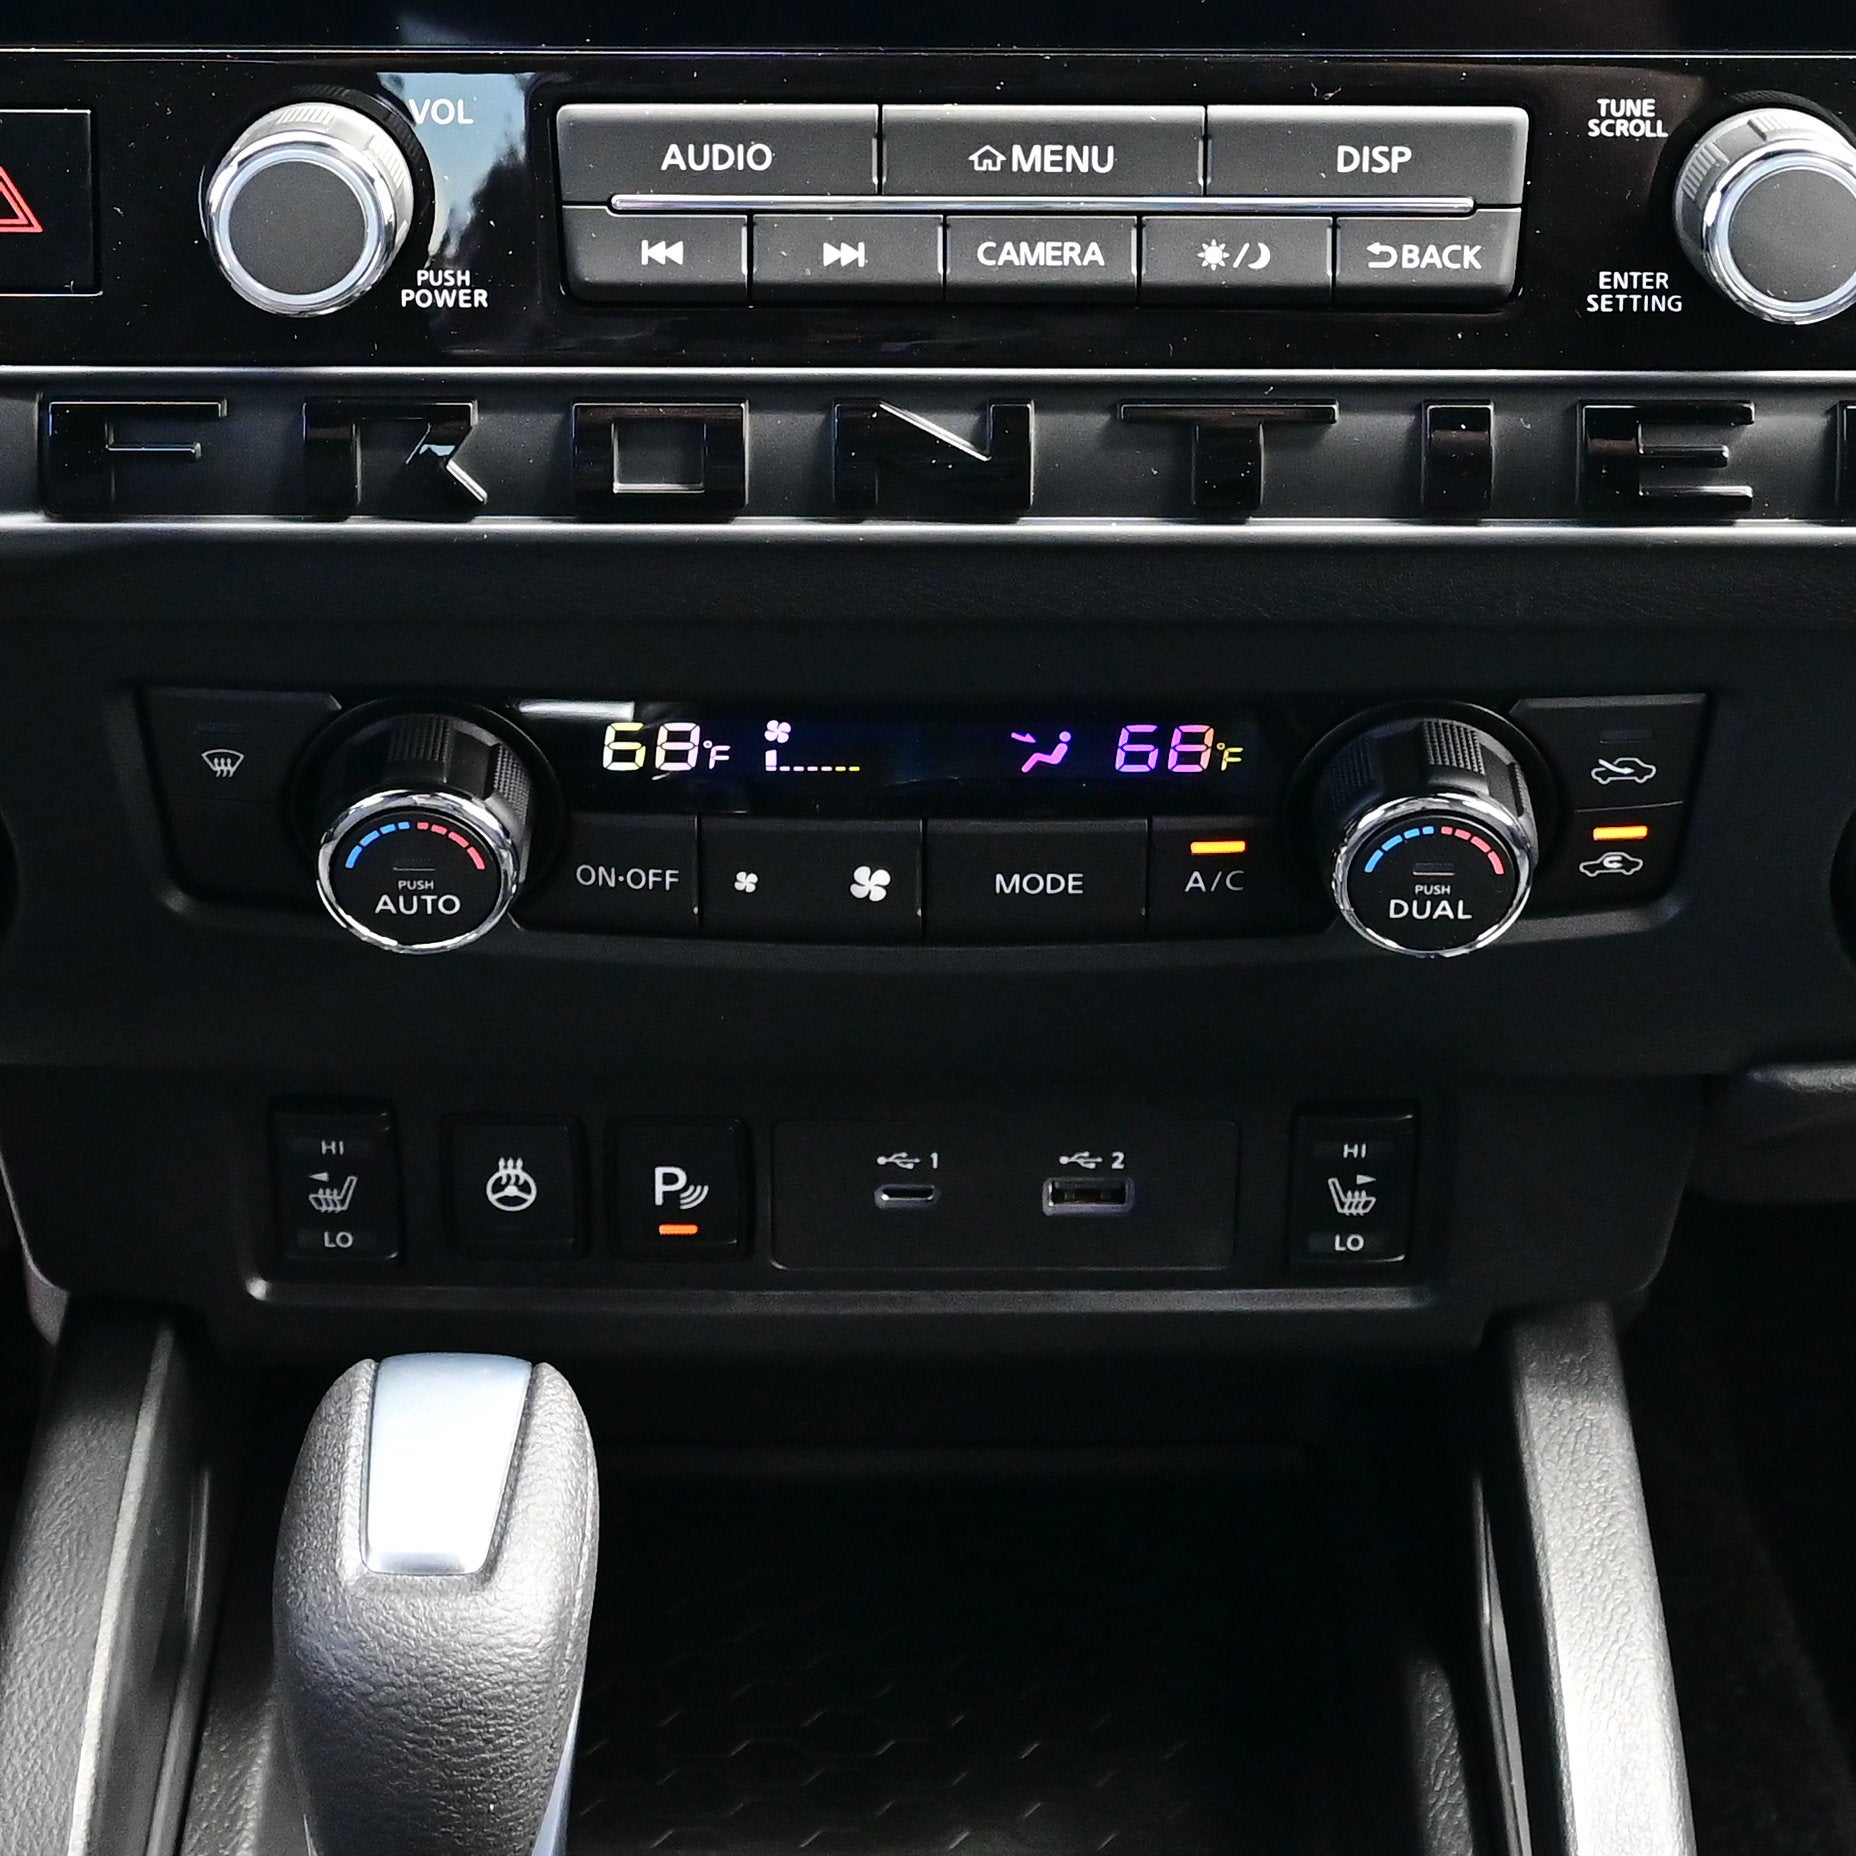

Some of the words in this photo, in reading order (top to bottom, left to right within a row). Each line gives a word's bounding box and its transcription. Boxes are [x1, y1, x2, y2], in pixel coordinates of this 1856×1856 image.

[407, 96, 476, 128] VOL
[1596, 98, 1656, 118] TUNE
[1587, 118, 1669, 138] SCROLL
[660, 143, 773, 171] AUDIO
[1011, 144, 1115, 174] MENU
[1336, 145, 1412, 174] DISP
[976, 241, 1106, 267] CAMERA
[1401, 244, 1482, 270] BACK
[416, 269, 471, 287] PUSH
[1598, 271, 1669, 290] ENTER
[401, 288, 489, 308] POWER
[1586, 294, 1683, 313] SETTING
[398, 879, 434, 891] PUSH
[995, 873, 1083, 895] MODE
[1184, 869, 1245, 894] A/C
[1414, 884, 1451, 896] PUSH
[375, 894, 461, 915] AUTO
[1389, 899, 1472, 920] DUAL
[321, 1140, 344, 1155] HI
[1343, 1143, 1367, 1158] HI
[930, 1152, 938, 1169] 1
[1111, 1151, 1125, 1169] 2
[324, 1231, 353, 1248] LO
[1334, 1234, 1364, 1252] LO
